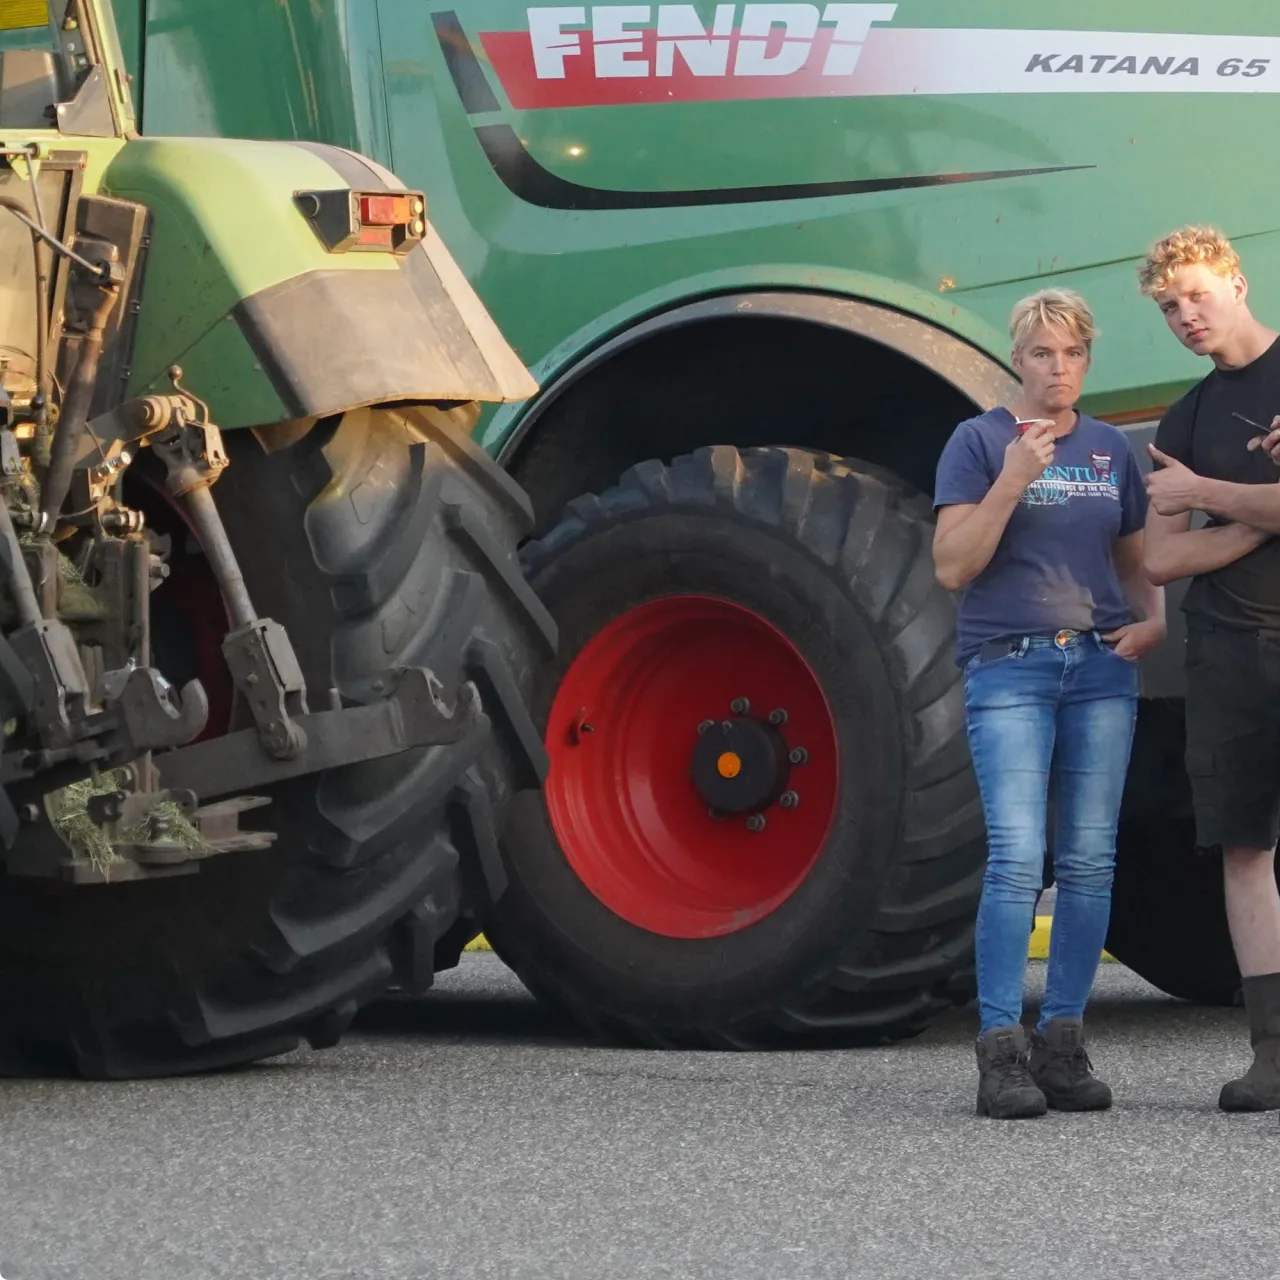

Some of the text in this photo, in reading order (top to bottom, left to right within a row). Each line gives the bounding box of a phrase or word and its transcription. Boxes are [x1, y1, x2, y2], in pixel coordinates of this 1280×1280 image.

[526, 2, 1270, 79] FENDT KATANA 65
